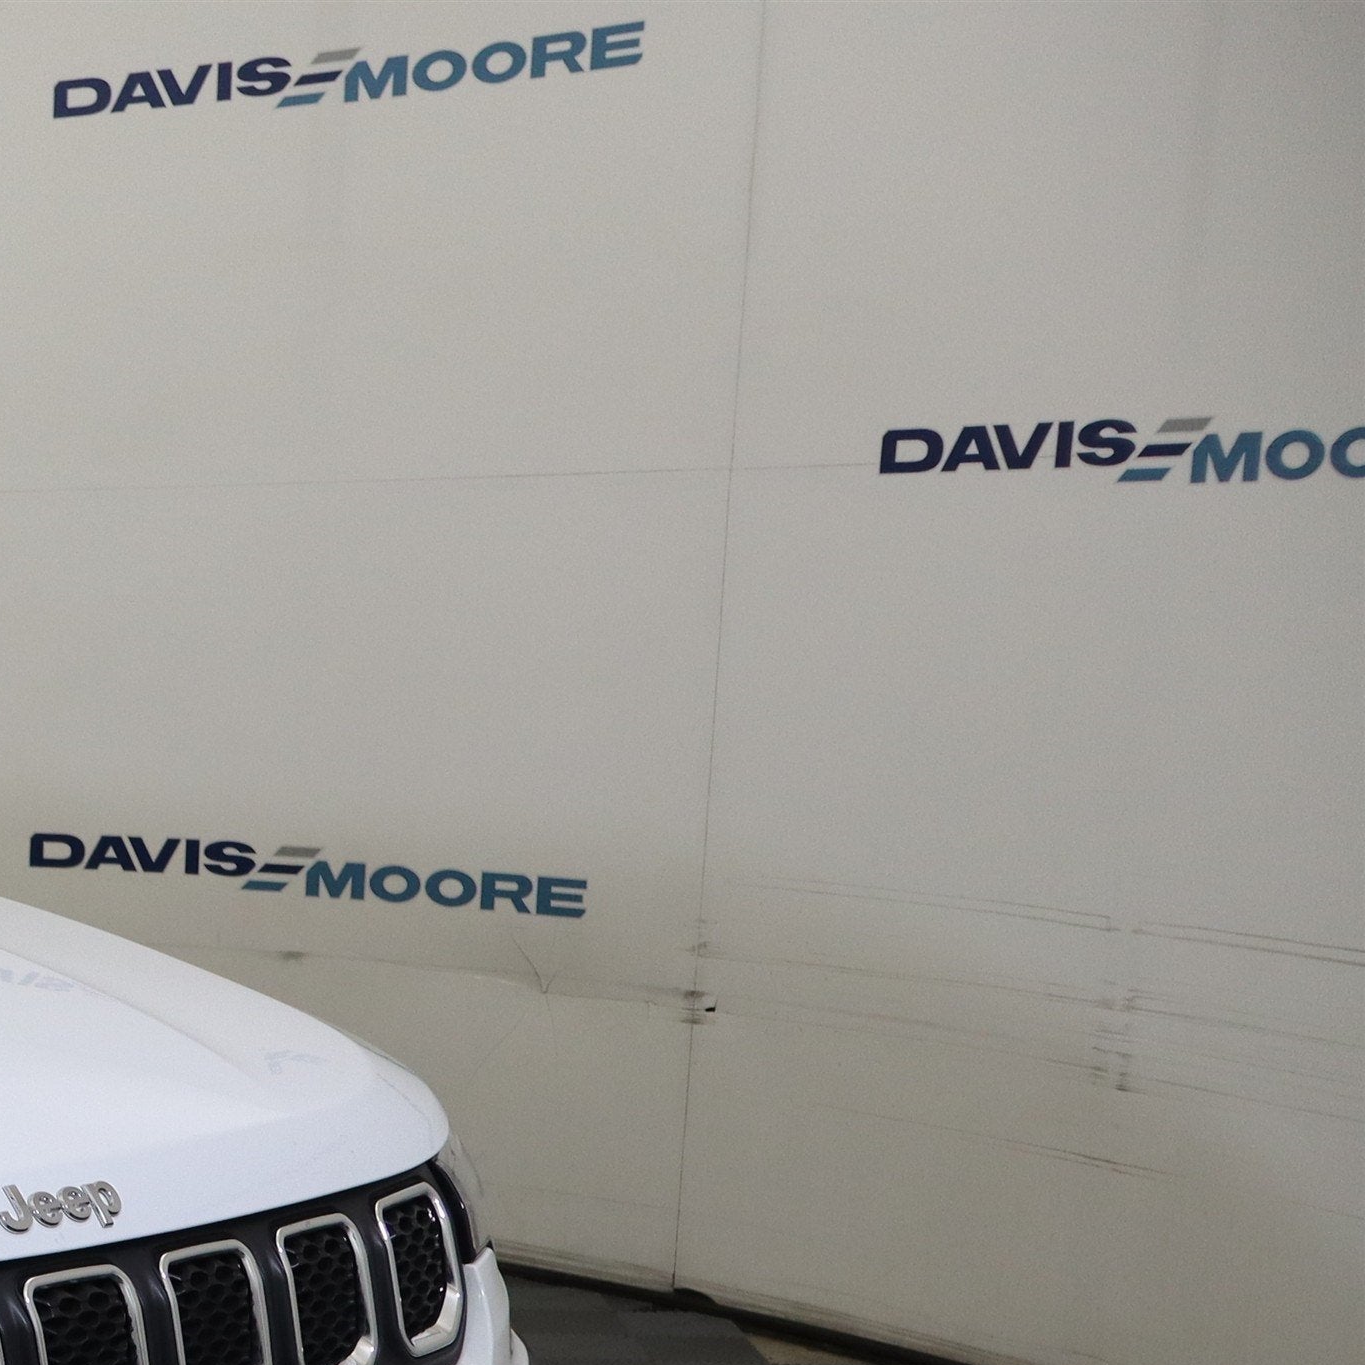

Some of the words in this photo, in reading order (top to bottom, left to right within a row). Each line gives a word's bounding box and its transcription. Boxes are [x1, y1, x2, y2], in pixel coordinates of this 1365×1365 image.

[52, 56, 292, 119] DAVIS
[343, 20, 646, 103] MOORE
[879, 418, 1137, 474] DAVIS
[28, 832, 256, 877] DAVIS
[305, 860, 588, 919] MOORE
